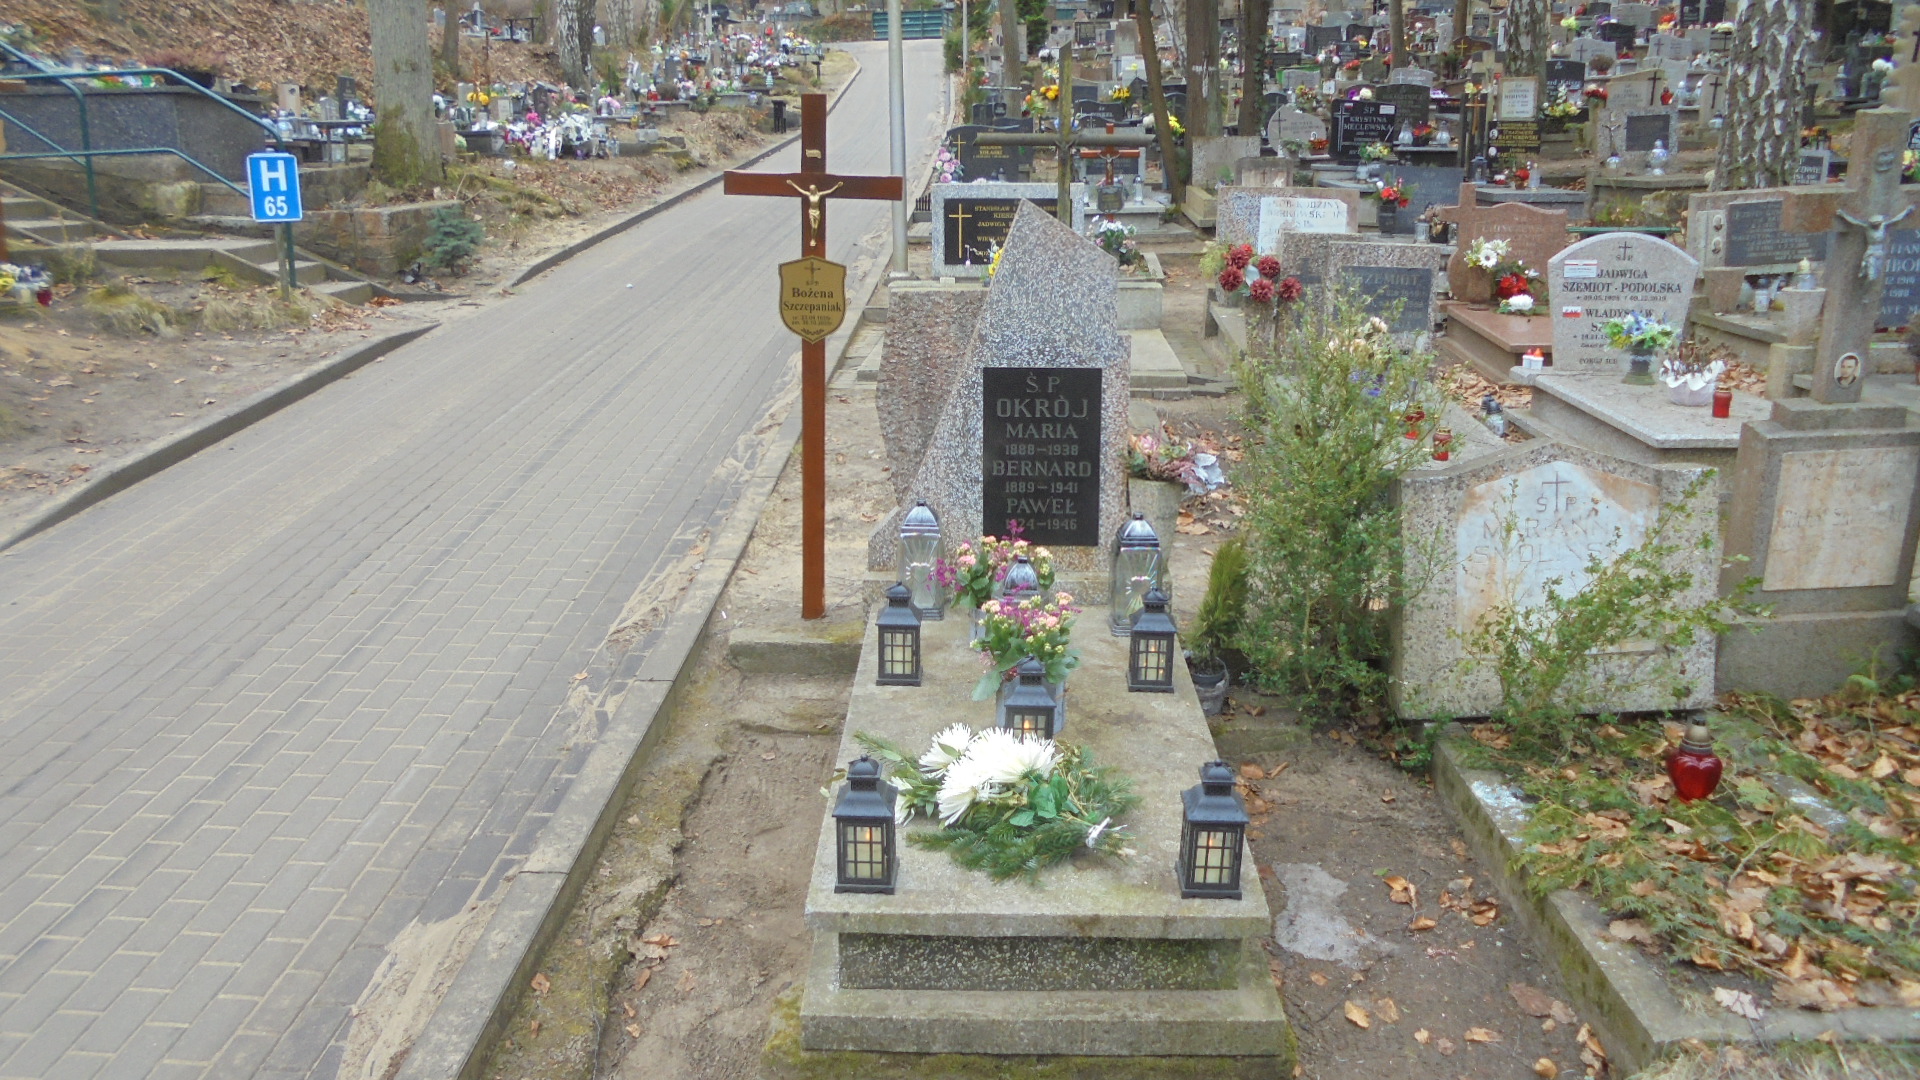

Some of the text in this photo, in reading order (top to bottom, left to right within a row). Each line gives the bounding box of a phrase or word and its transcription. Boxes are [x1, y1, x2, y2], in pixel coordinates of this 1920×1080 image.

[260, 159, 288, 192] H
[264, 195, 288, 217] 65
[1597, 269, 1648, 279] JADWIGA
[792, 287, 834, 299] Bożena
[1562, 282, 1611, 292] SZEMIOT
[1620, 283, 1681, 292] PODOLSKA
[783, 301, 842, 314] Szczepaniak
[1585, 308, 1654, 318] WŁADYSW
[996, 395, 1089, 418] OKRÓJ
[1006, 423, 1078, 439] MARIA
[992, 460, 1092, 477] BERNARD
[1006, 498, 1078, 514] PAWEŁ
